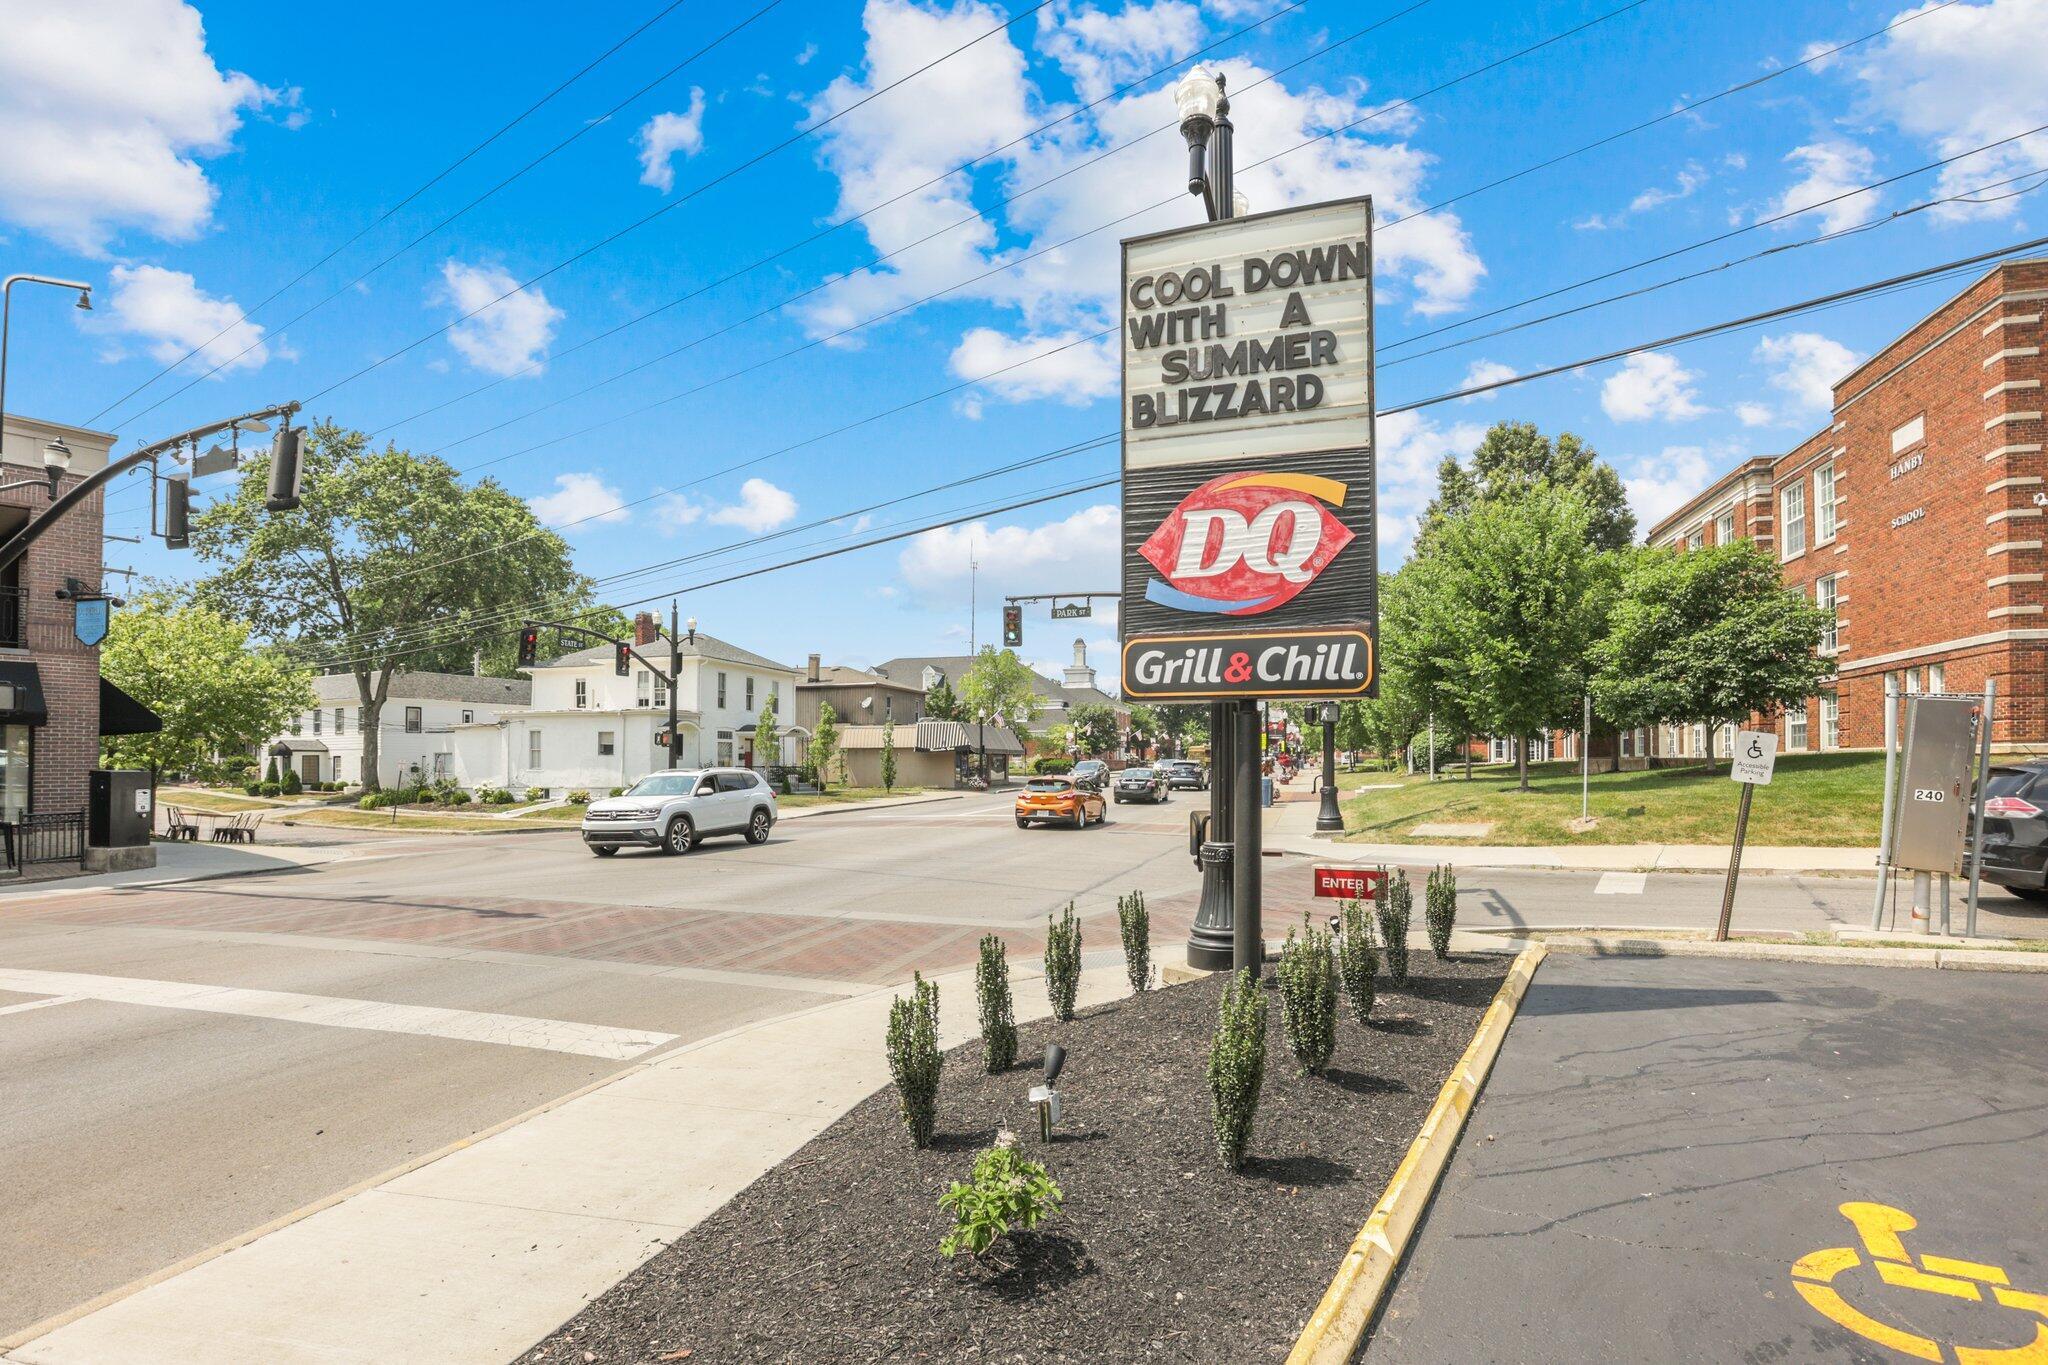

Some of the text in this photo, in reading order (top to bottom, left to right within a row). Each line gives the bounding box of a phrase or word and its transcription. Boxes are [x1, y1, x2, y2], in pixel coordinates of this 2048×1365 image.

[1129, 241, 1366, 309] COOL DOWN
[1128, 291, 1311, 349] WITH A
[1161, 330, 1338, 384] SUMMER
[1132, 373, 1324, 428] BLIZZARD
[1890, 453, 1925, 480] HANBY
[1891, 507, 1926, 529] SCHOOL
[1170, 500, 1322, 583] DQ
[1056, 609, 1078, 618] PARK
[560, 639, 578, 648] STATE
[1740, 767, 1765, 777] Parking
[1916, 790, 1943, 801] 240
[1321, 877, 1364, 891] ENTER
